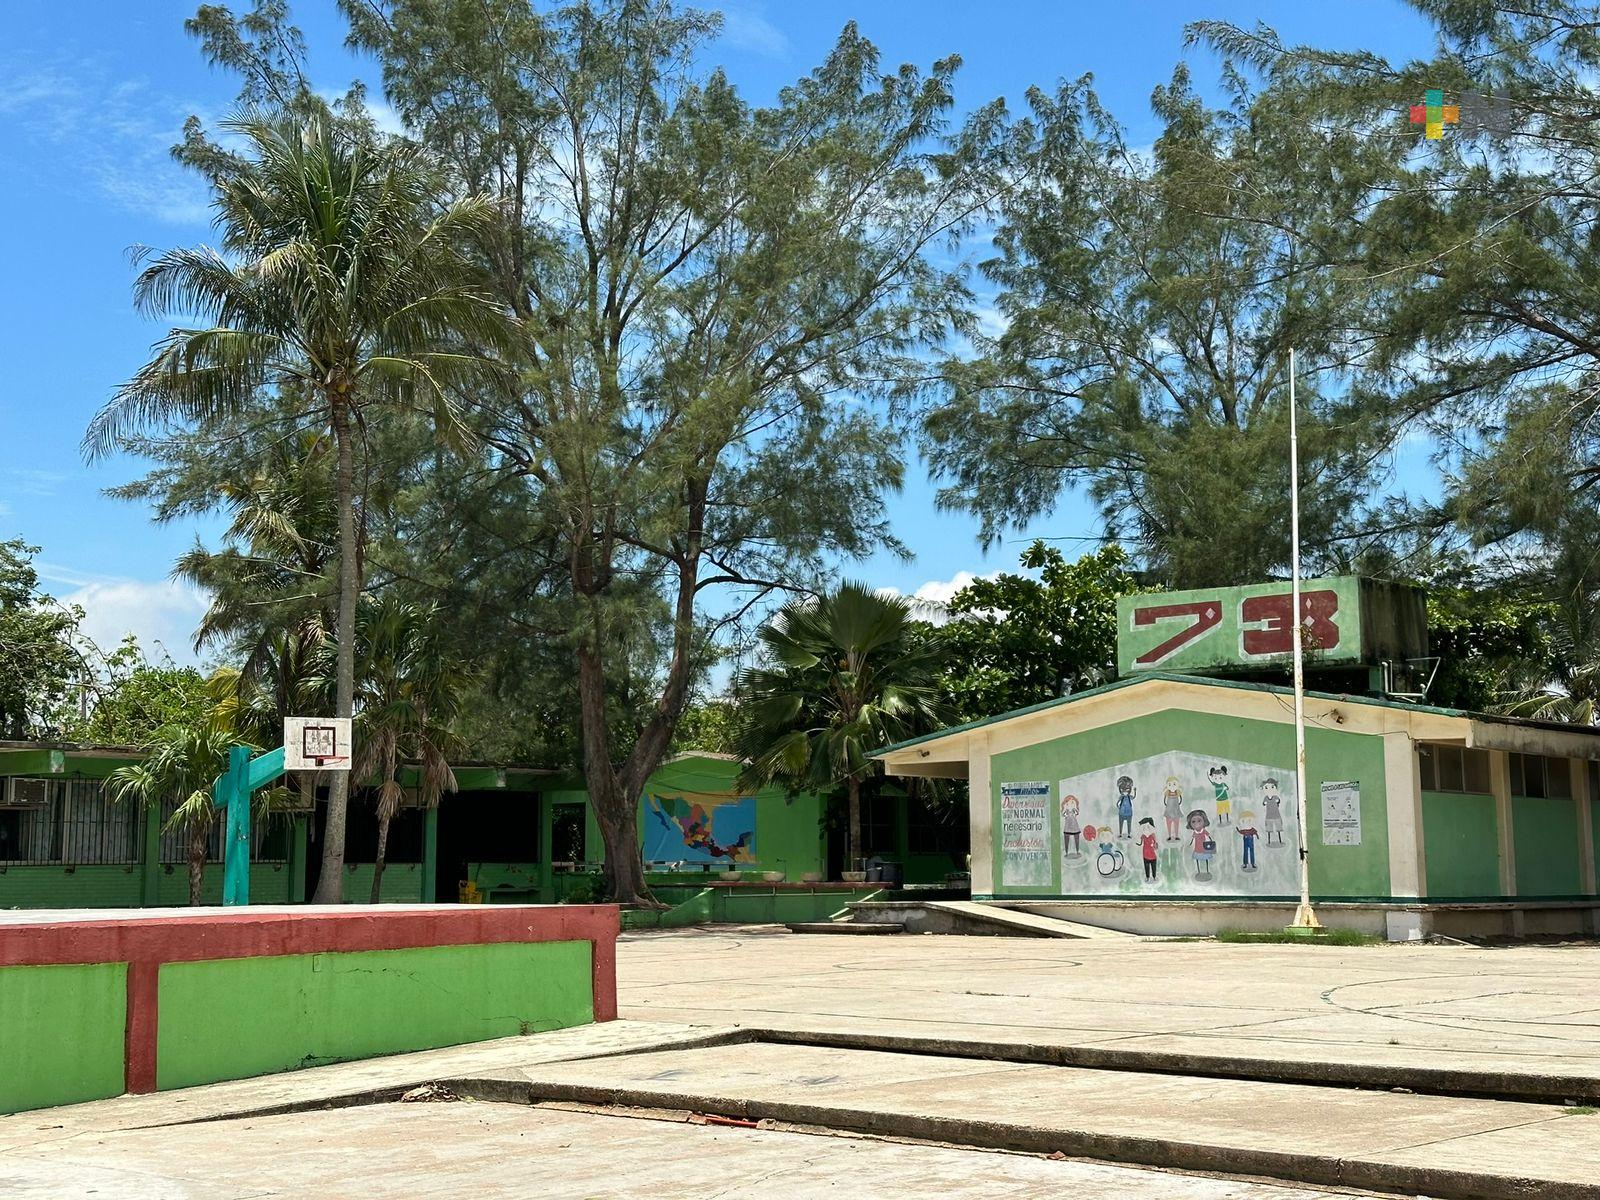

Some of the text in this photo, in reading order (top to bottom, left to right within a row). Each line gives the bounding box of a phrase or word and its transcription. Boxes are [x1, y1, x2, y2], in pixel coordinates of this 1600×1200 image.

[1130, 590, 1340, 669] 73
[1014, 809, 1045, 818] NORMAL
[1004, 821, 1042, 831] necesario
